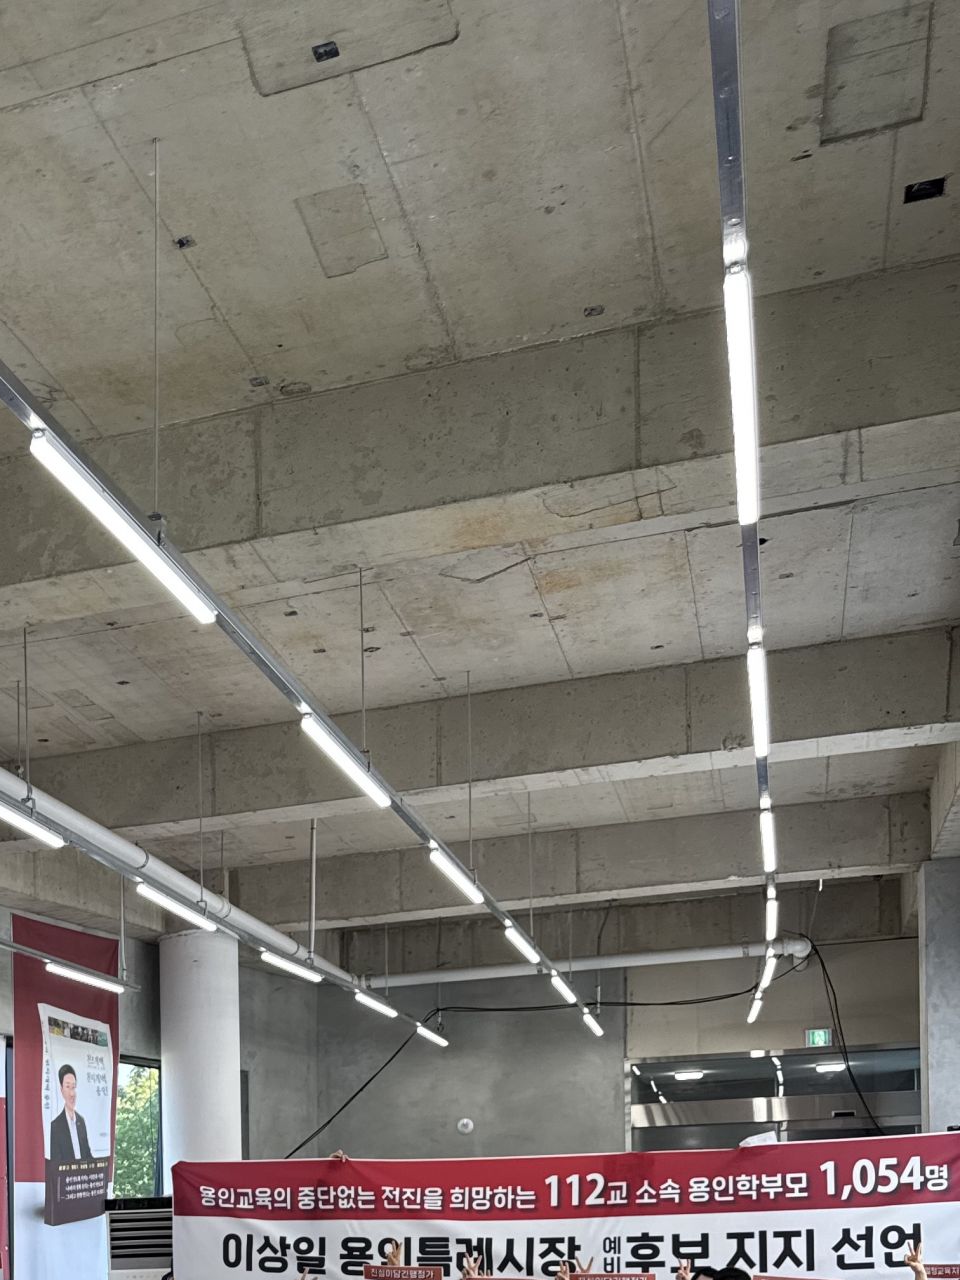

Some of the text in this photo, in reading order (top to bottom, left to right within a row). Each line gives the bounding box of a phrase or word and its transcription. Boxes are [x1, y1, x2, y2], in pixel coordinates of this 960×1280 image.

[199, 1185, 291, 1211] 용인교육의
[297, 1185, 376, 1210] 중단없는
[381, 1186, 443, 1211] 전진을
[449, 1185, 537, 1211] 희망하는
[635, 1177, 680, 1204] 소속
[688, 1172, 808, 1202] 용인학부모
[819, 1156, 949, 1201] 1,054명
[222, 1232, 327, 1275] 이상일
[339, 1235, 582, 1277] 용인특례시장
[726, 1228, 815, 1273] 지지
[831, 1222, 923, 1271] 선언
